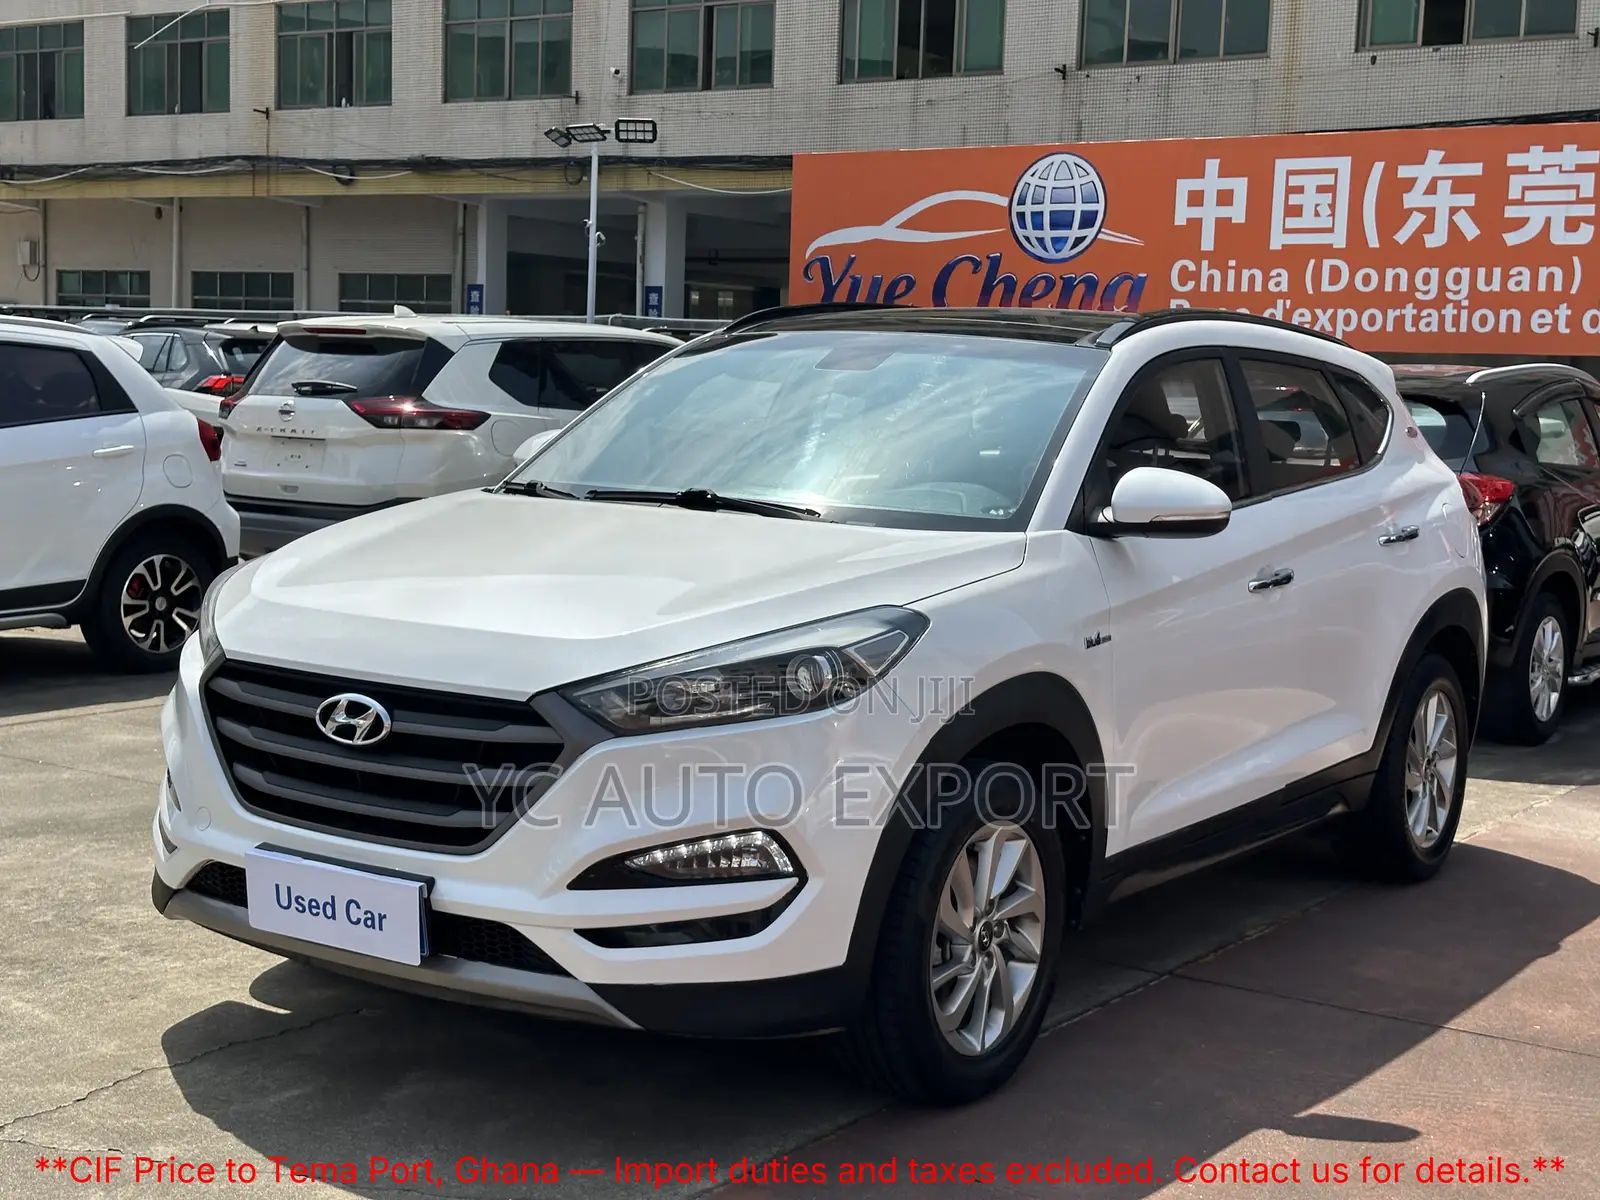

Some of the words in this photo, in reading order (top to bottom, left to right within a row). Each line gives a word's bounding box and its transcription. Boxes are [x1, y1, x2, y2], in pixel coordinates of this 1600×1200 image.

[803, 254, 917, 308] Yue
[1170, 259, 1289, 293] China
[1304, 255, 1582, 300] (Dongguan)
[1530, 302, 1572, 334] et
[275, 883, 337, 921] Used
[345, 898, 388, 932] Car
